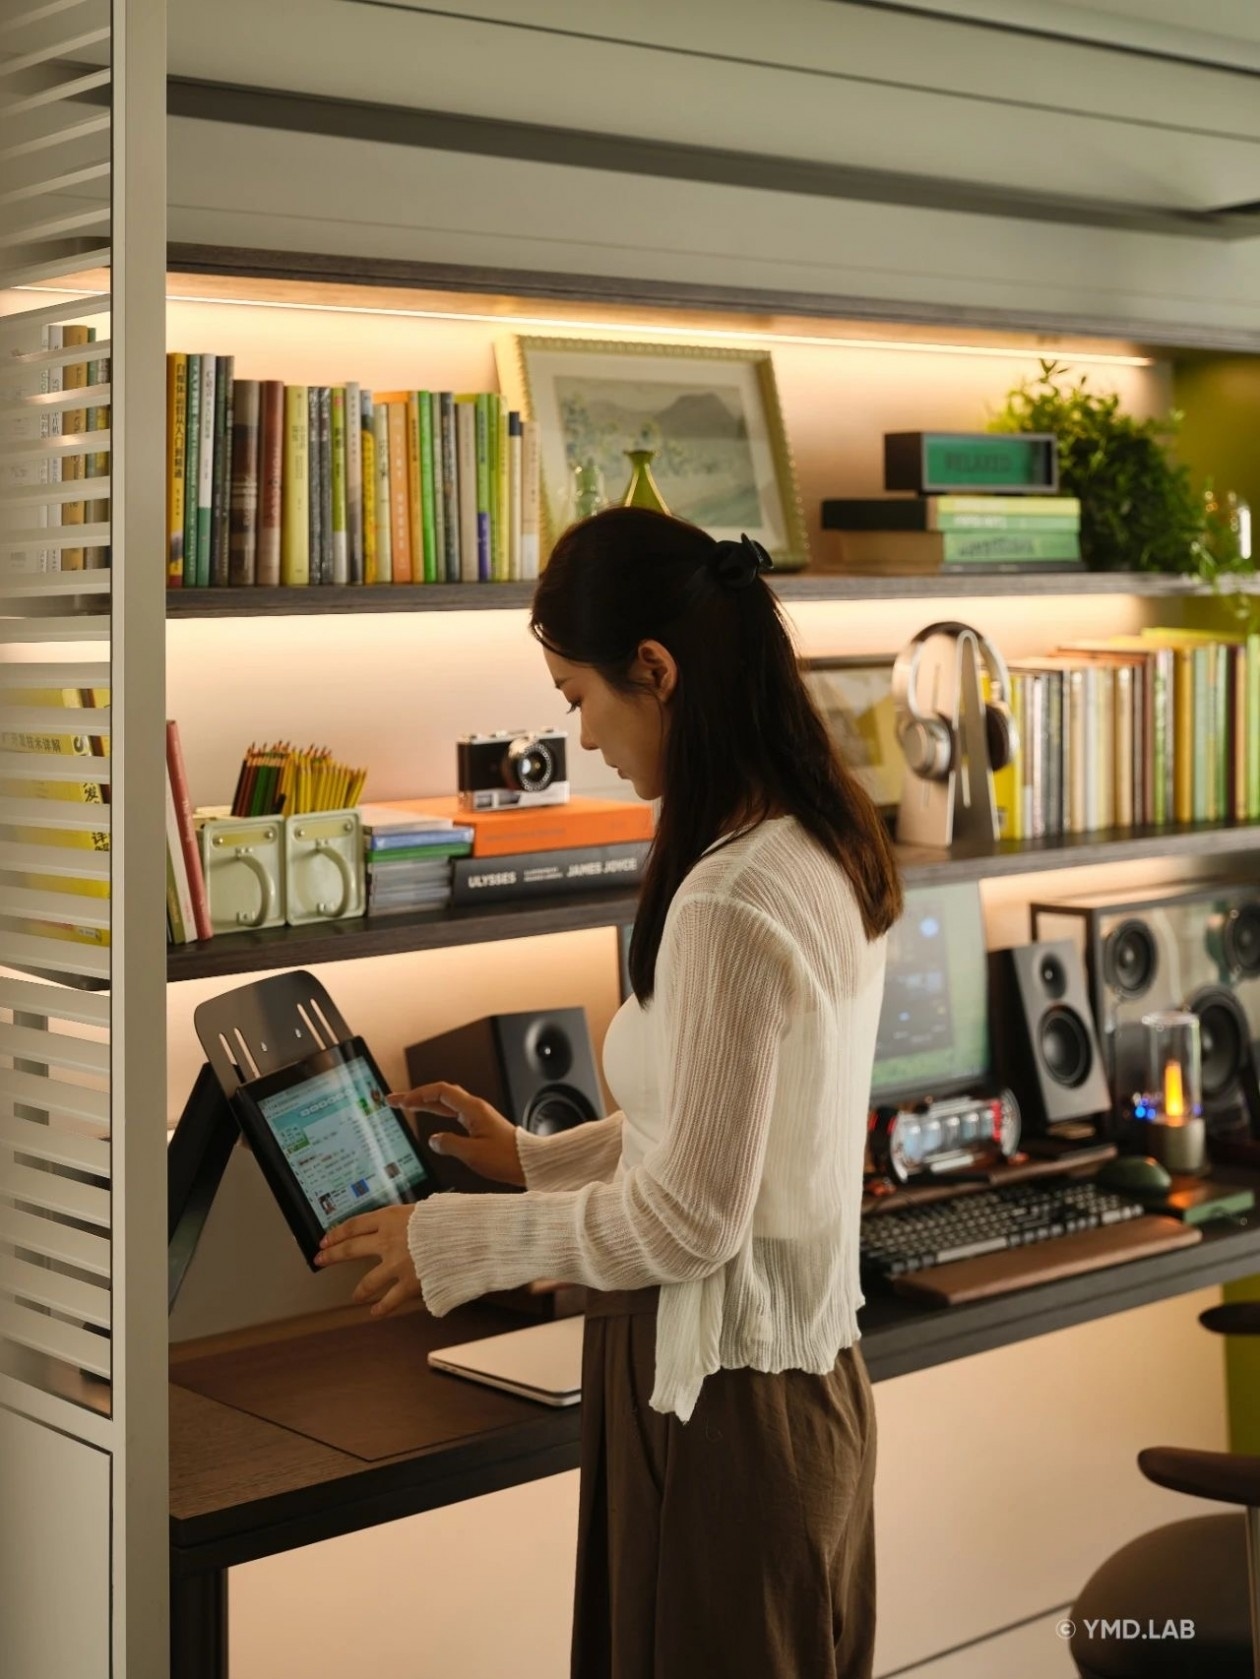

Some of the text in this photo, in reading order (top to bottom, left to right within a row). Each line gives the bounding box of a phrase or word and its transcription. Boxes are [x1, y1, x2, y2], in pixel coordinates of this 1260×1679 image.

[467, 870, 517, 889] ULYSSES
[566, 861, 602, 878] JAMES
[602, 857, 638, 874] JOYCE
